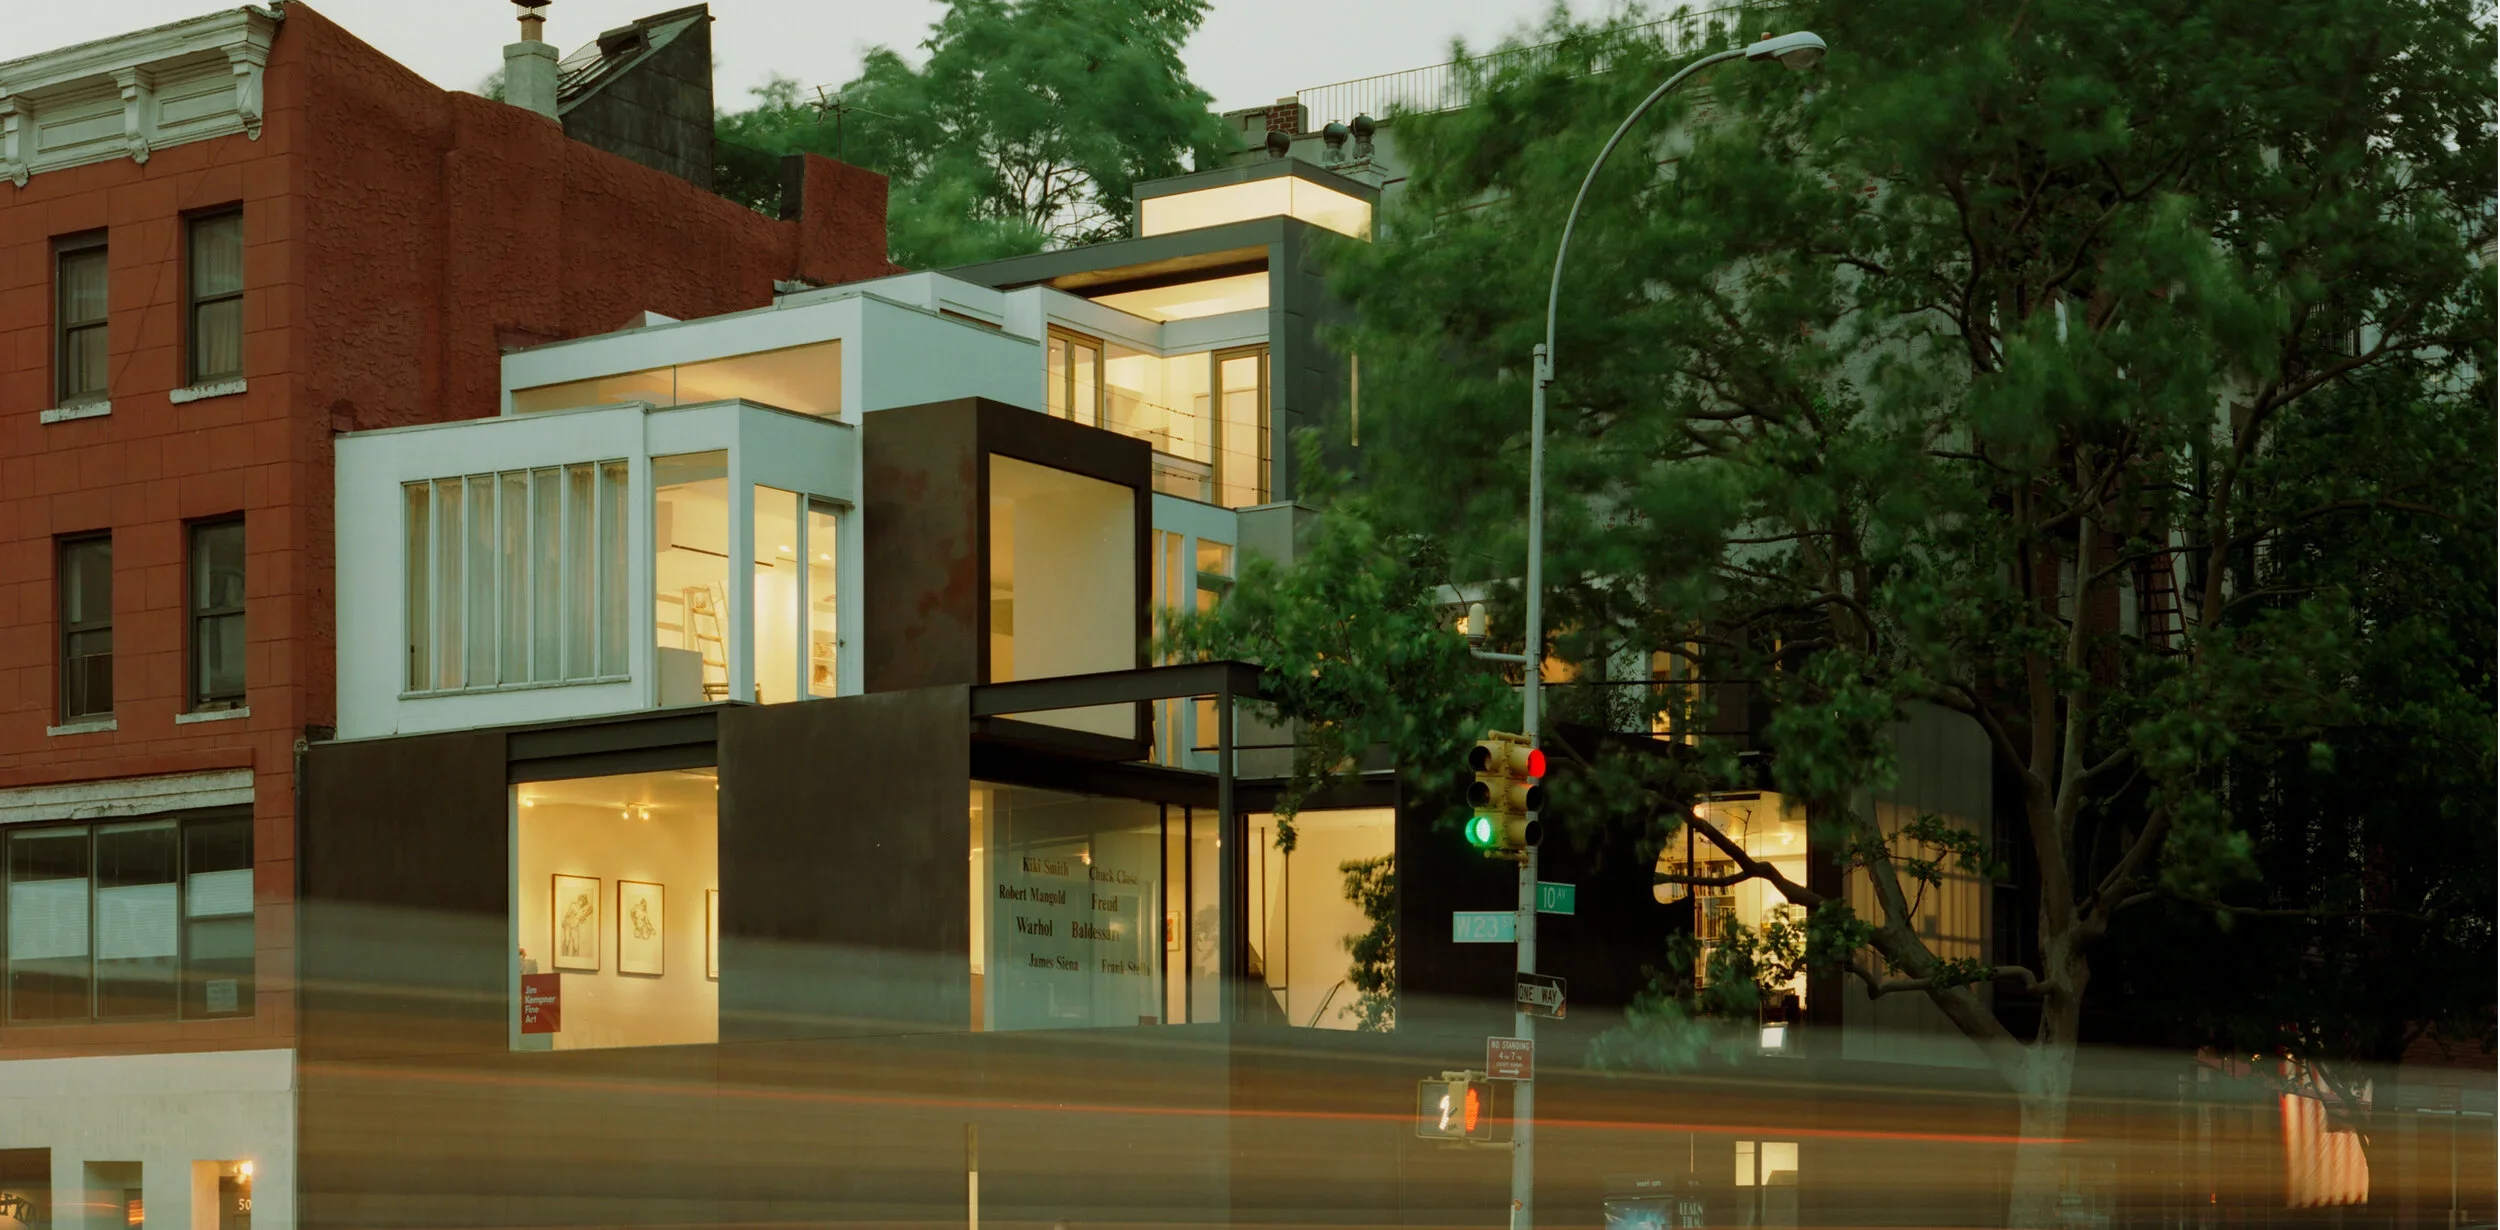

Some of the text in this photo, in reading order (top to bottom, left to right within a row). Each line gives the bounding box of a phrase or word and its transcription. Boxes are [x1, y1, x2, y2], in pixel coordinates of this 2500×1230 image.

[1023, 857, 1069, 876] Kiki Smith
[1089, 866, 1138, 885] Chuck Close
[999, 884, 1066, 906] Robert Mangold
[1092, 893, 1118, 912] Freud
[1543, 887, 1566, 909] 10 AV
[1016, 916, 1053, 937] Warhol
[1456, 915, 1470, 938] W
[1473, 915, 1499, 939] 23
[1028, 953, 1079, 972] James Siena
[1101, 959, 1125, 974] Frank
[526, 986, 537, 994] Jim
[1519, 985, 1558, 1004] ONE WAY
[525, 996, 556, 1005] Kempner
[525, 1005, 539, 1013] Fine
[525, 1015, 537, 1023] Art
[1491, 1040, 1530, 1051] NO STANDING
